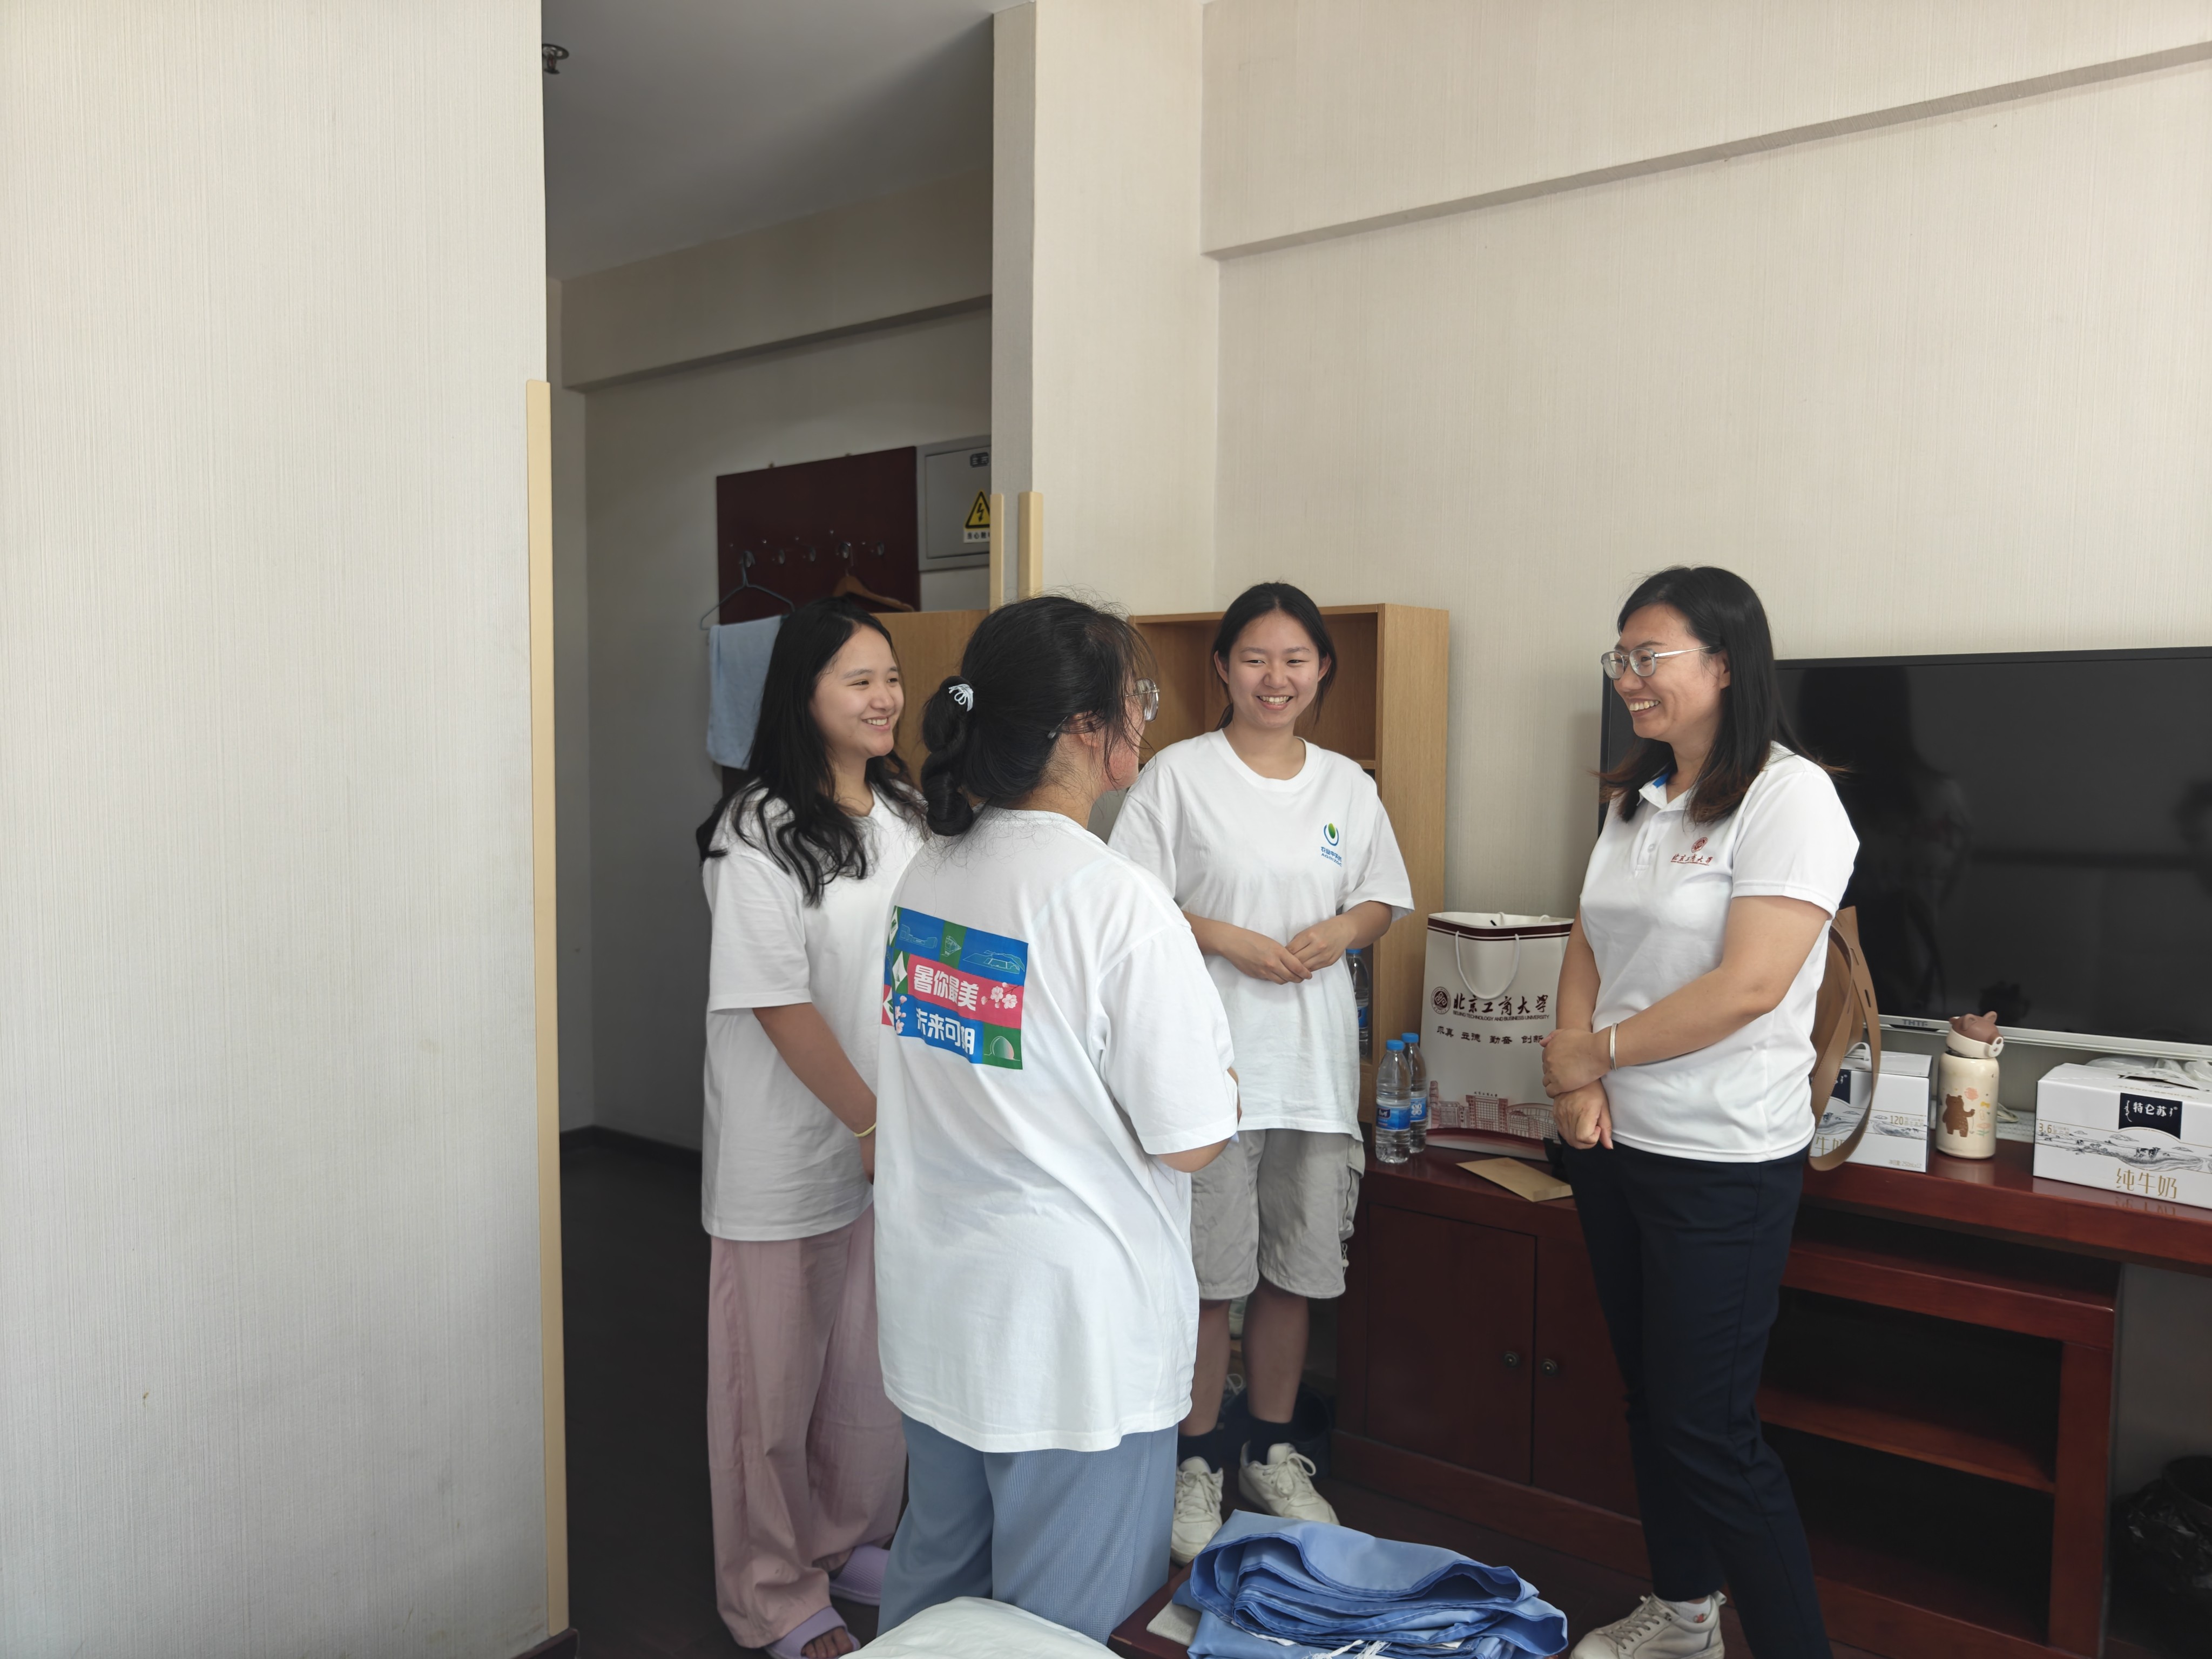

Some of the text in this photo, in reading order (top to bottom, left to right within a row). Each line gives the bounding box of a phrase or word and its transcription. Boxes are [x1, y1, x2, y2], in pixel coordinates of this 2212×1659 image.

[914, 964, 979, 1011] 暑你最美
[1453, 993, 1549, 1016] 北京工商大学
[1437, 1026, 1454, 1038] 求真
[1489, 1035, 1513, 1044] 勤奋
[2133, 1102, 2167, 1117] 特仑苏
[1890, 1115, 1904, 1125] 120
[2039, 1123, 2052, 1134] 3.6
[2116, 1168, 2177, 1199] 纯牛奶
